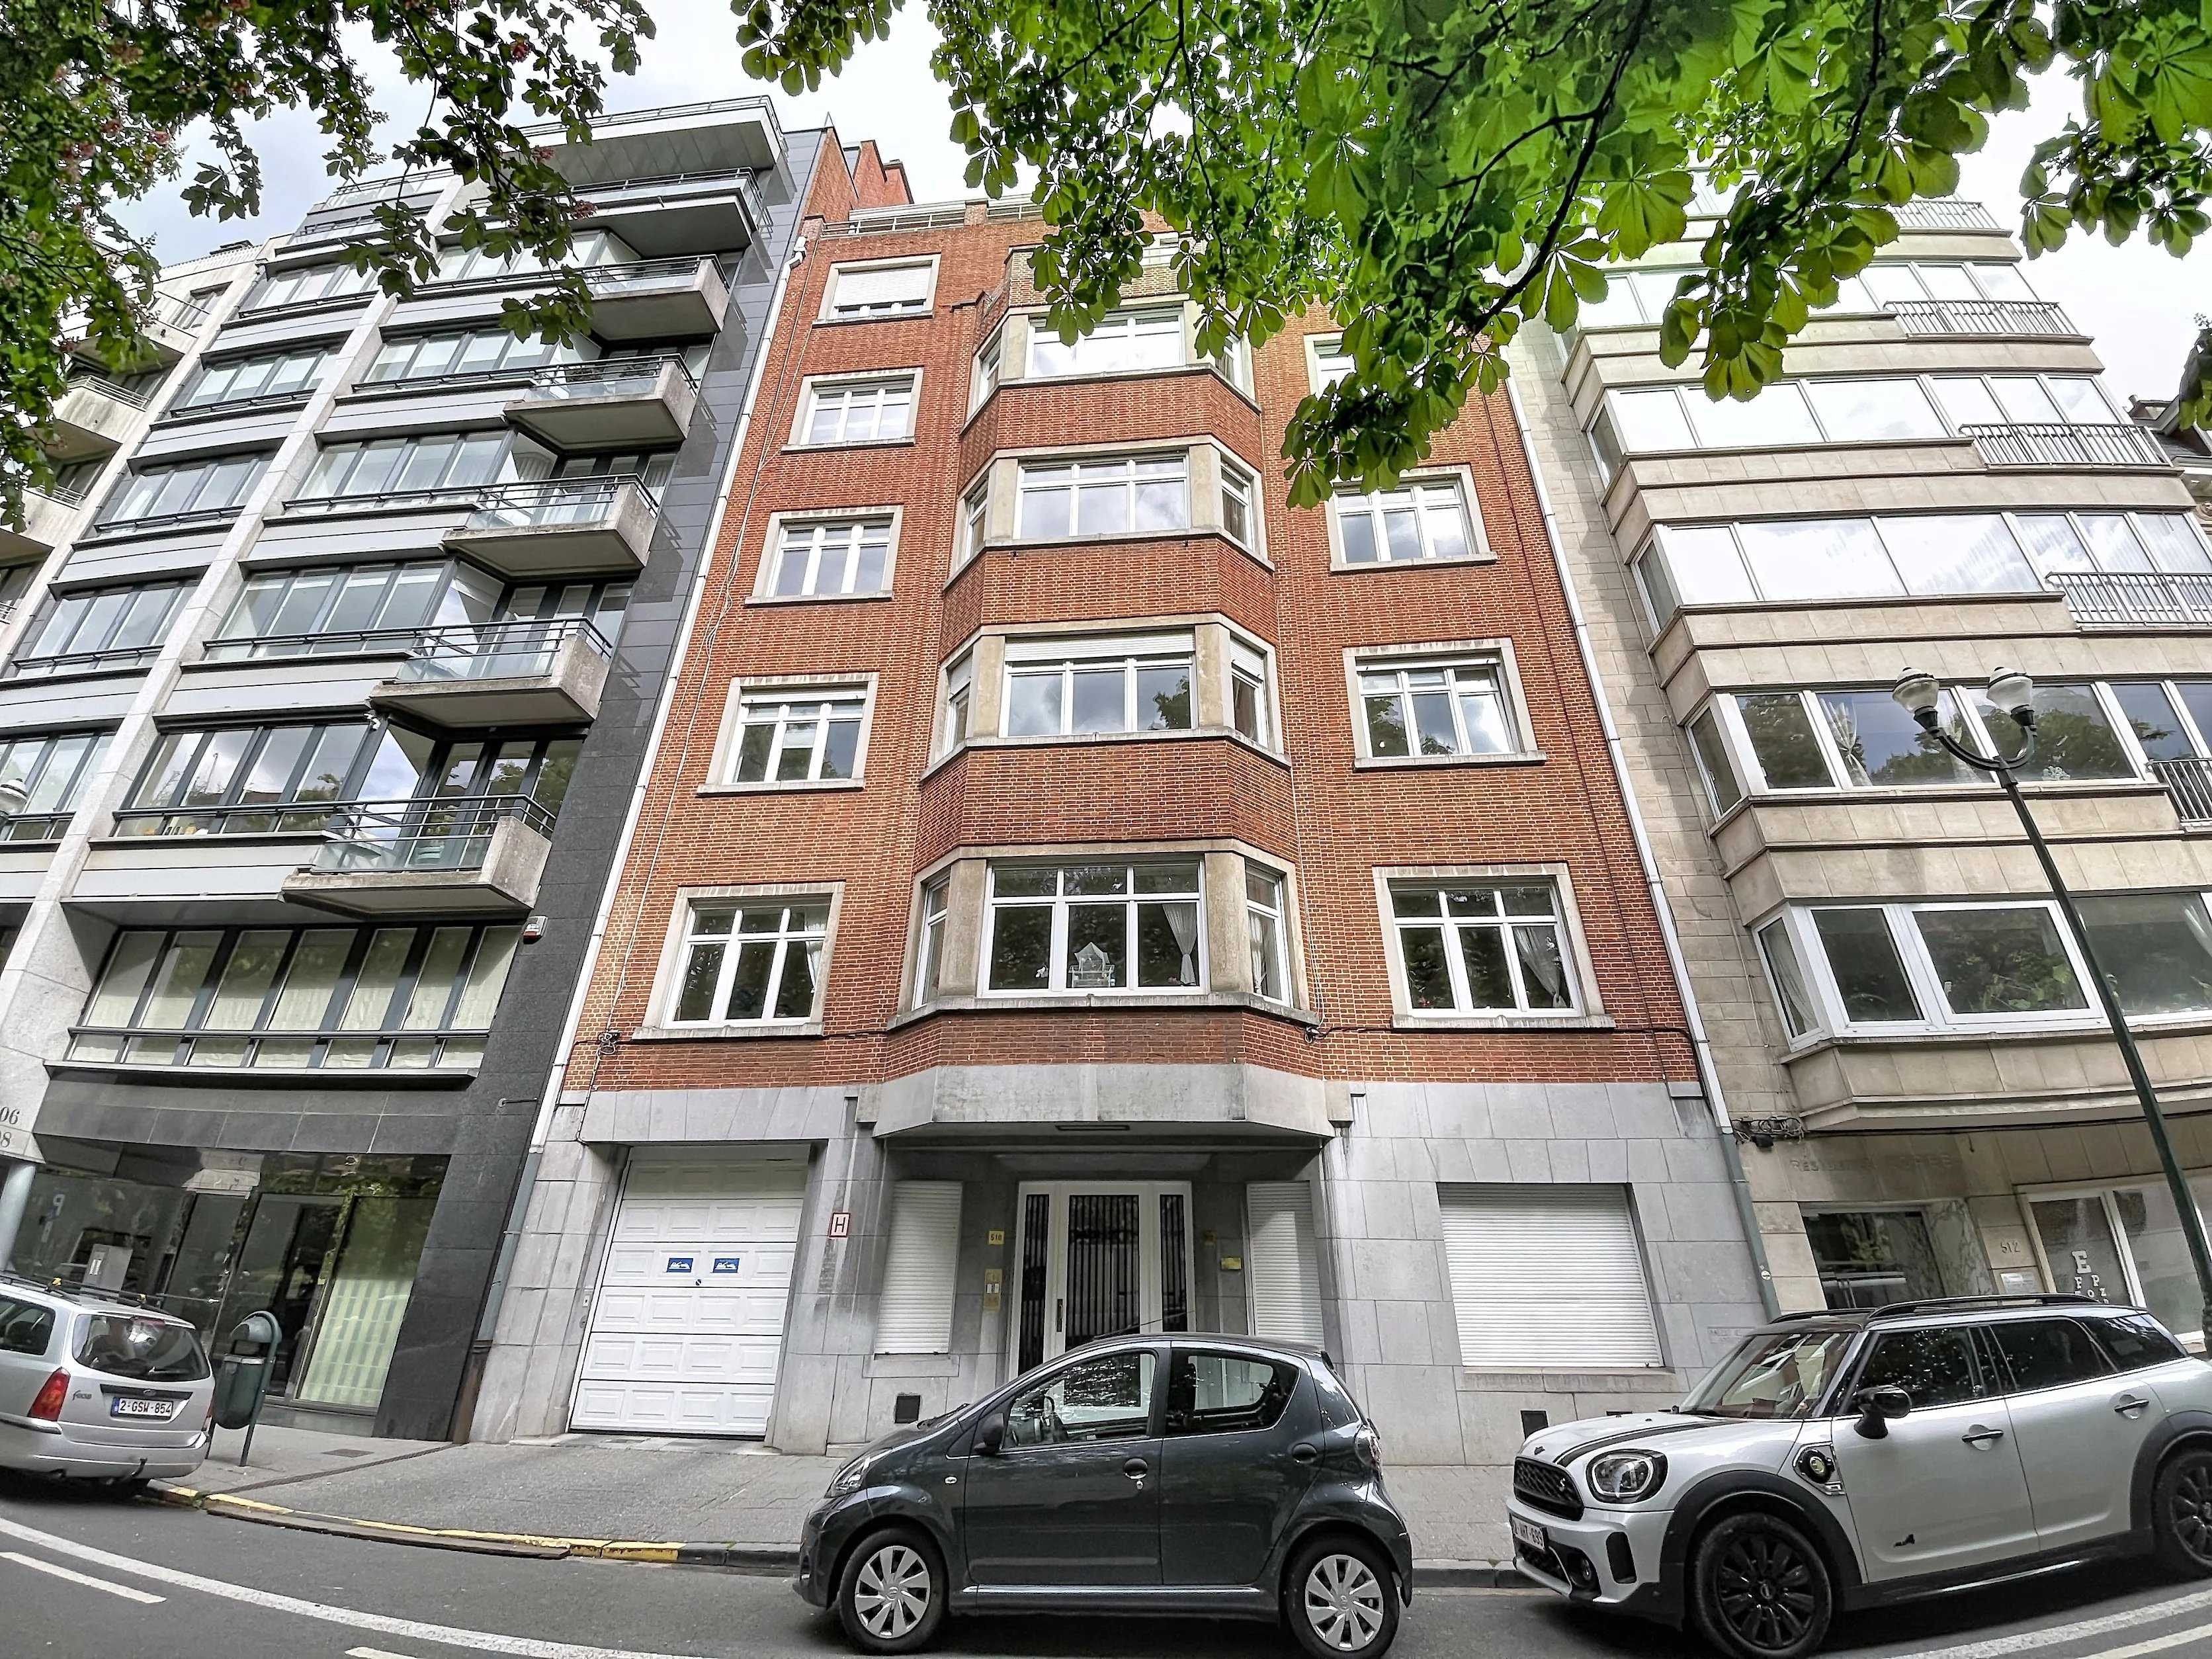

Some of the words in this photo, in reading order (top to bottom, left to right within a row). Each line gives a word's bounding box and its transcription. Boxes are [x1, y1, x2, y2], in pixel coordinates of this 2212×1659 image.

[0, 1130, 12, 1148] 8
[834, 1217, 846, 1232] H
[2000, 1242, 2020, 1254] 512
[2072, 1250, 2092, 1274] E
[2074, 1276, 2082, 1289] F
[2092, 1274, 2100, 1287] P
[2088, 1289, 2095, 1298] O
[120, 1400, 172, 1414] 2-GSW-854
